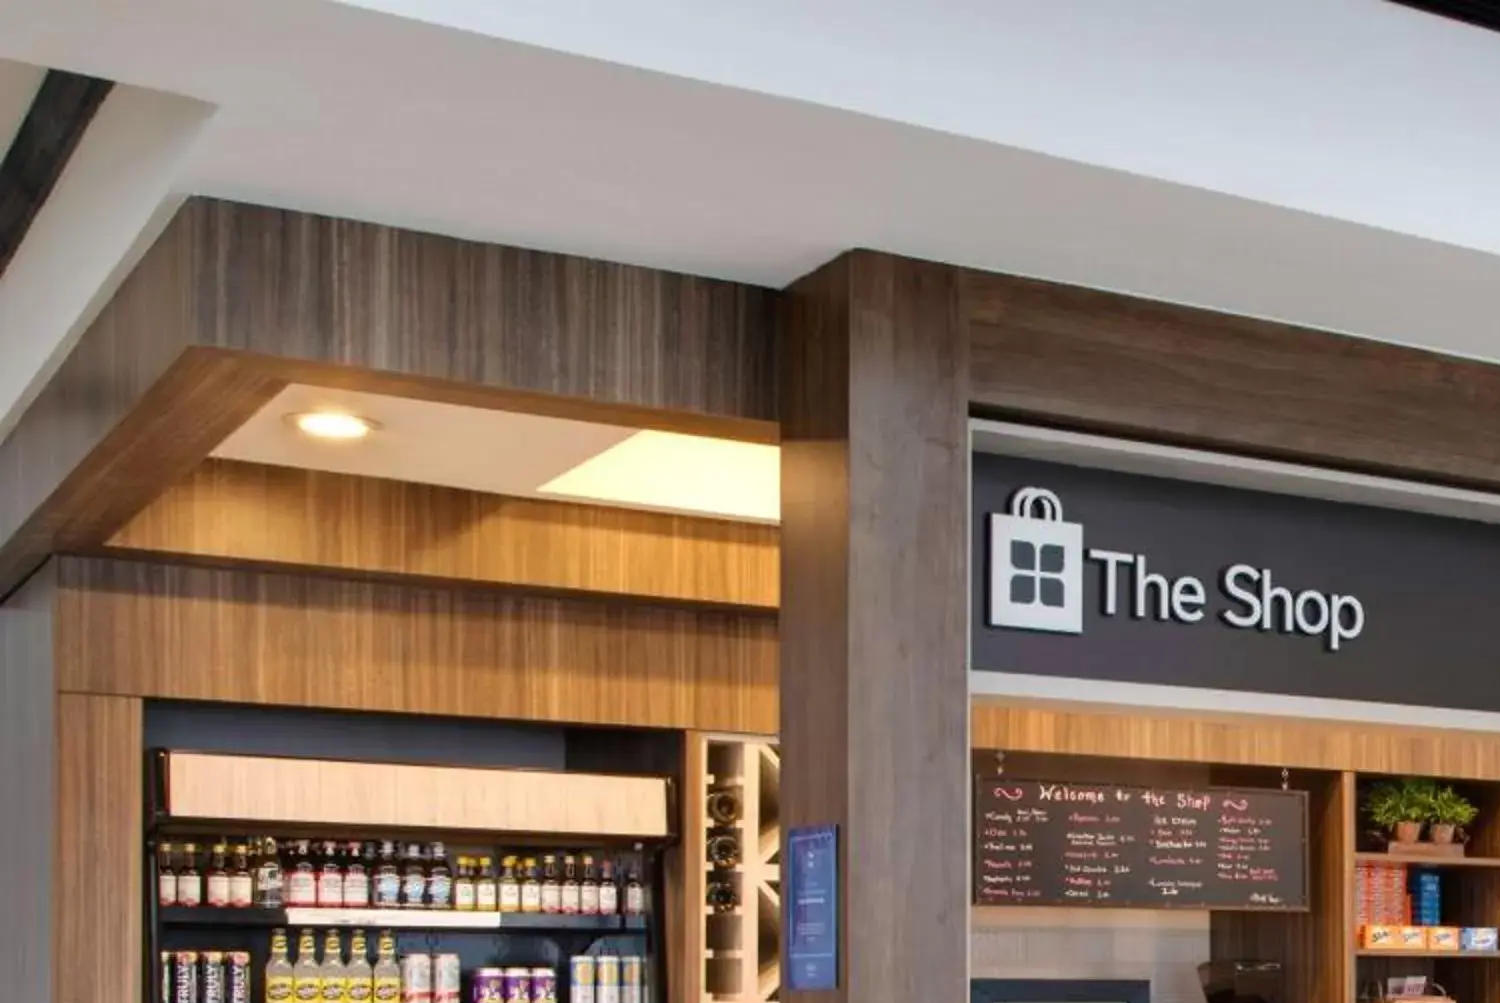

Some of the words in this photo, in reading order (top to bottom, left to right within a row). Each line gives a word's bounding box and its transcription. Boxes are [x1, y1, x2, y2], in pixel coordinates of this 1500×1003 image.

[1089, 548, 1206, 622] The
[1222, 563, 1364, 649] Shop
[1039, 784, 1104, 803] Welcome
[1116, 789, 1131, 801] to
[1142, 791, 1166, 807] the
[1177, 792, 1211, 811] Shop
